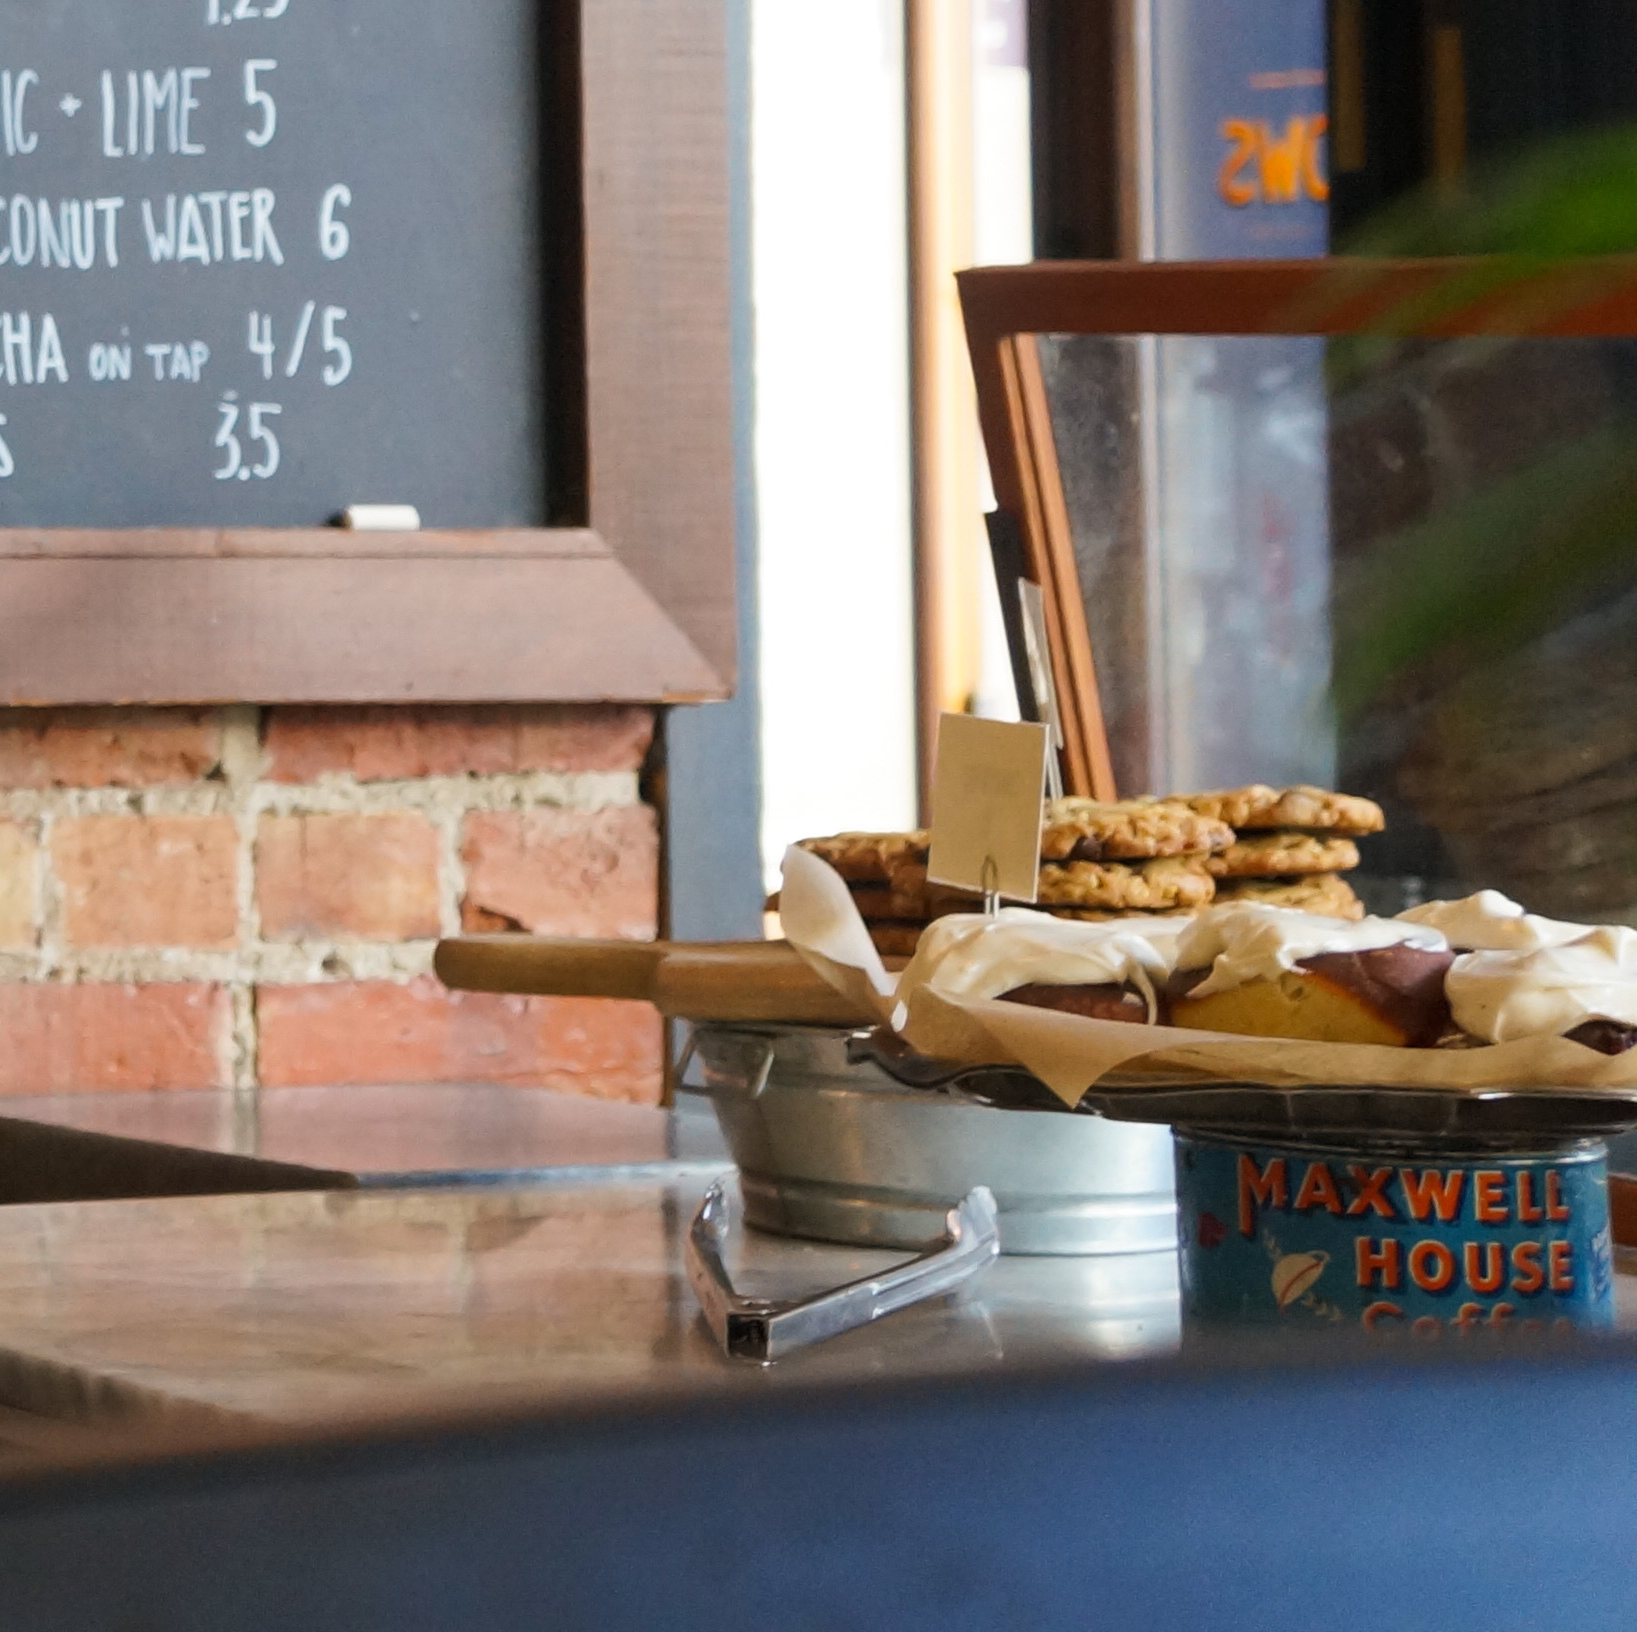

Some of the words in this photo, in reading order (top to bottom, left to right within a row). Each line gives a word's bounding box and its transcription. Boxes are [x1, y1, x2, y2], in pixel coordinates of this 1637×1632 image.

[101, 67, 212, 158] LIME
[243, 58, 278, 148] 5
[141, 187, 285, 266] WATER
[318, 183, 352, 262] 6
[89, 341, 132, 381] ON
[144, 340, 211, 383] TAP
[214, 401, 282, 482] 3.5
[1236, 1153, 1571, 1238] MAXWELL
[1354, 1235, 1574, 1294] HOUSE
